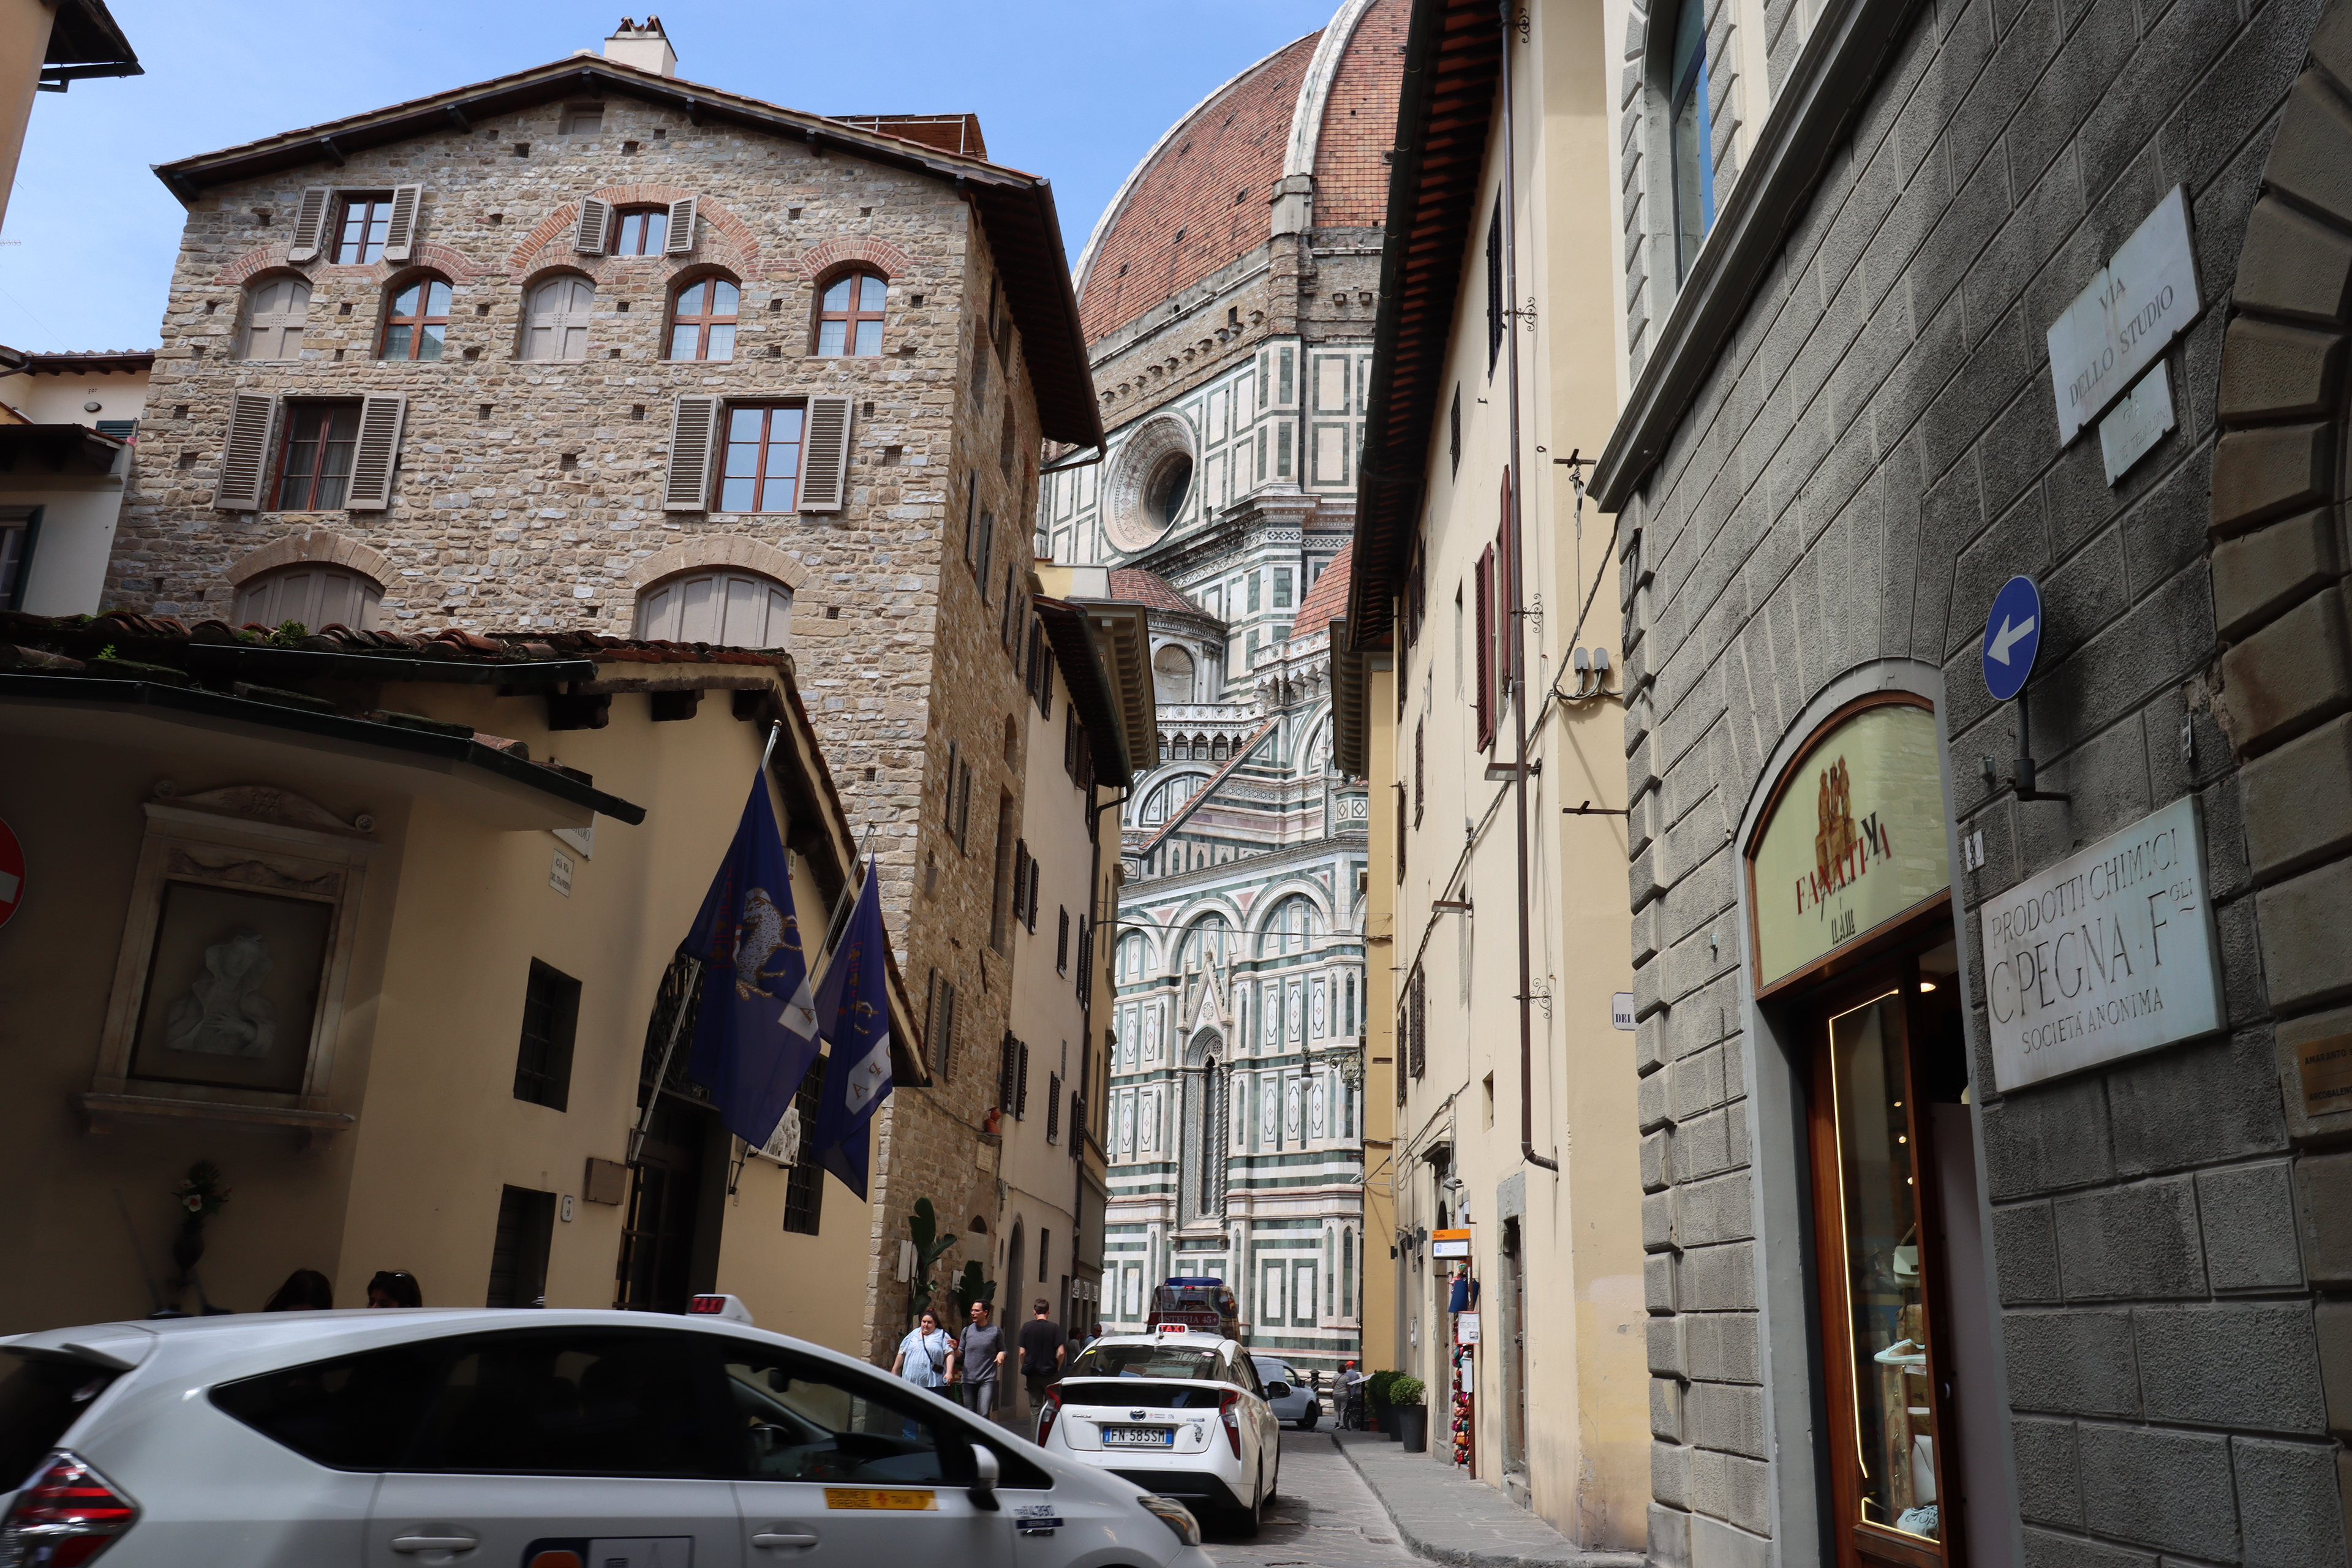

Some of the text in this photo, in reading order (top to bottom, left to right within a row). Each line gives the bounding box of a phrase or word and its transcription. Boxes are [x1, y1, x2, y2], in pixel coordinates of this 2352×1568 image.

[2098, 277, 2127, 311] VIA
[2070, 285, 2174, 407] DELLO STUDIO
[571, 828, 590, 842] UDIO
[1992, 827, 2179, 949] PRODOTTI CHIMICI
[2088, 986, 2164, 1033] ANONIMA
[1615, 1013, 1631, 1023] DEI
[2305, 1049, 2347, 1065] AMARANTO
[690, 1298, 725, 1313] TAXI
[1158, 1315, 1199, 1324] OSTERIA
